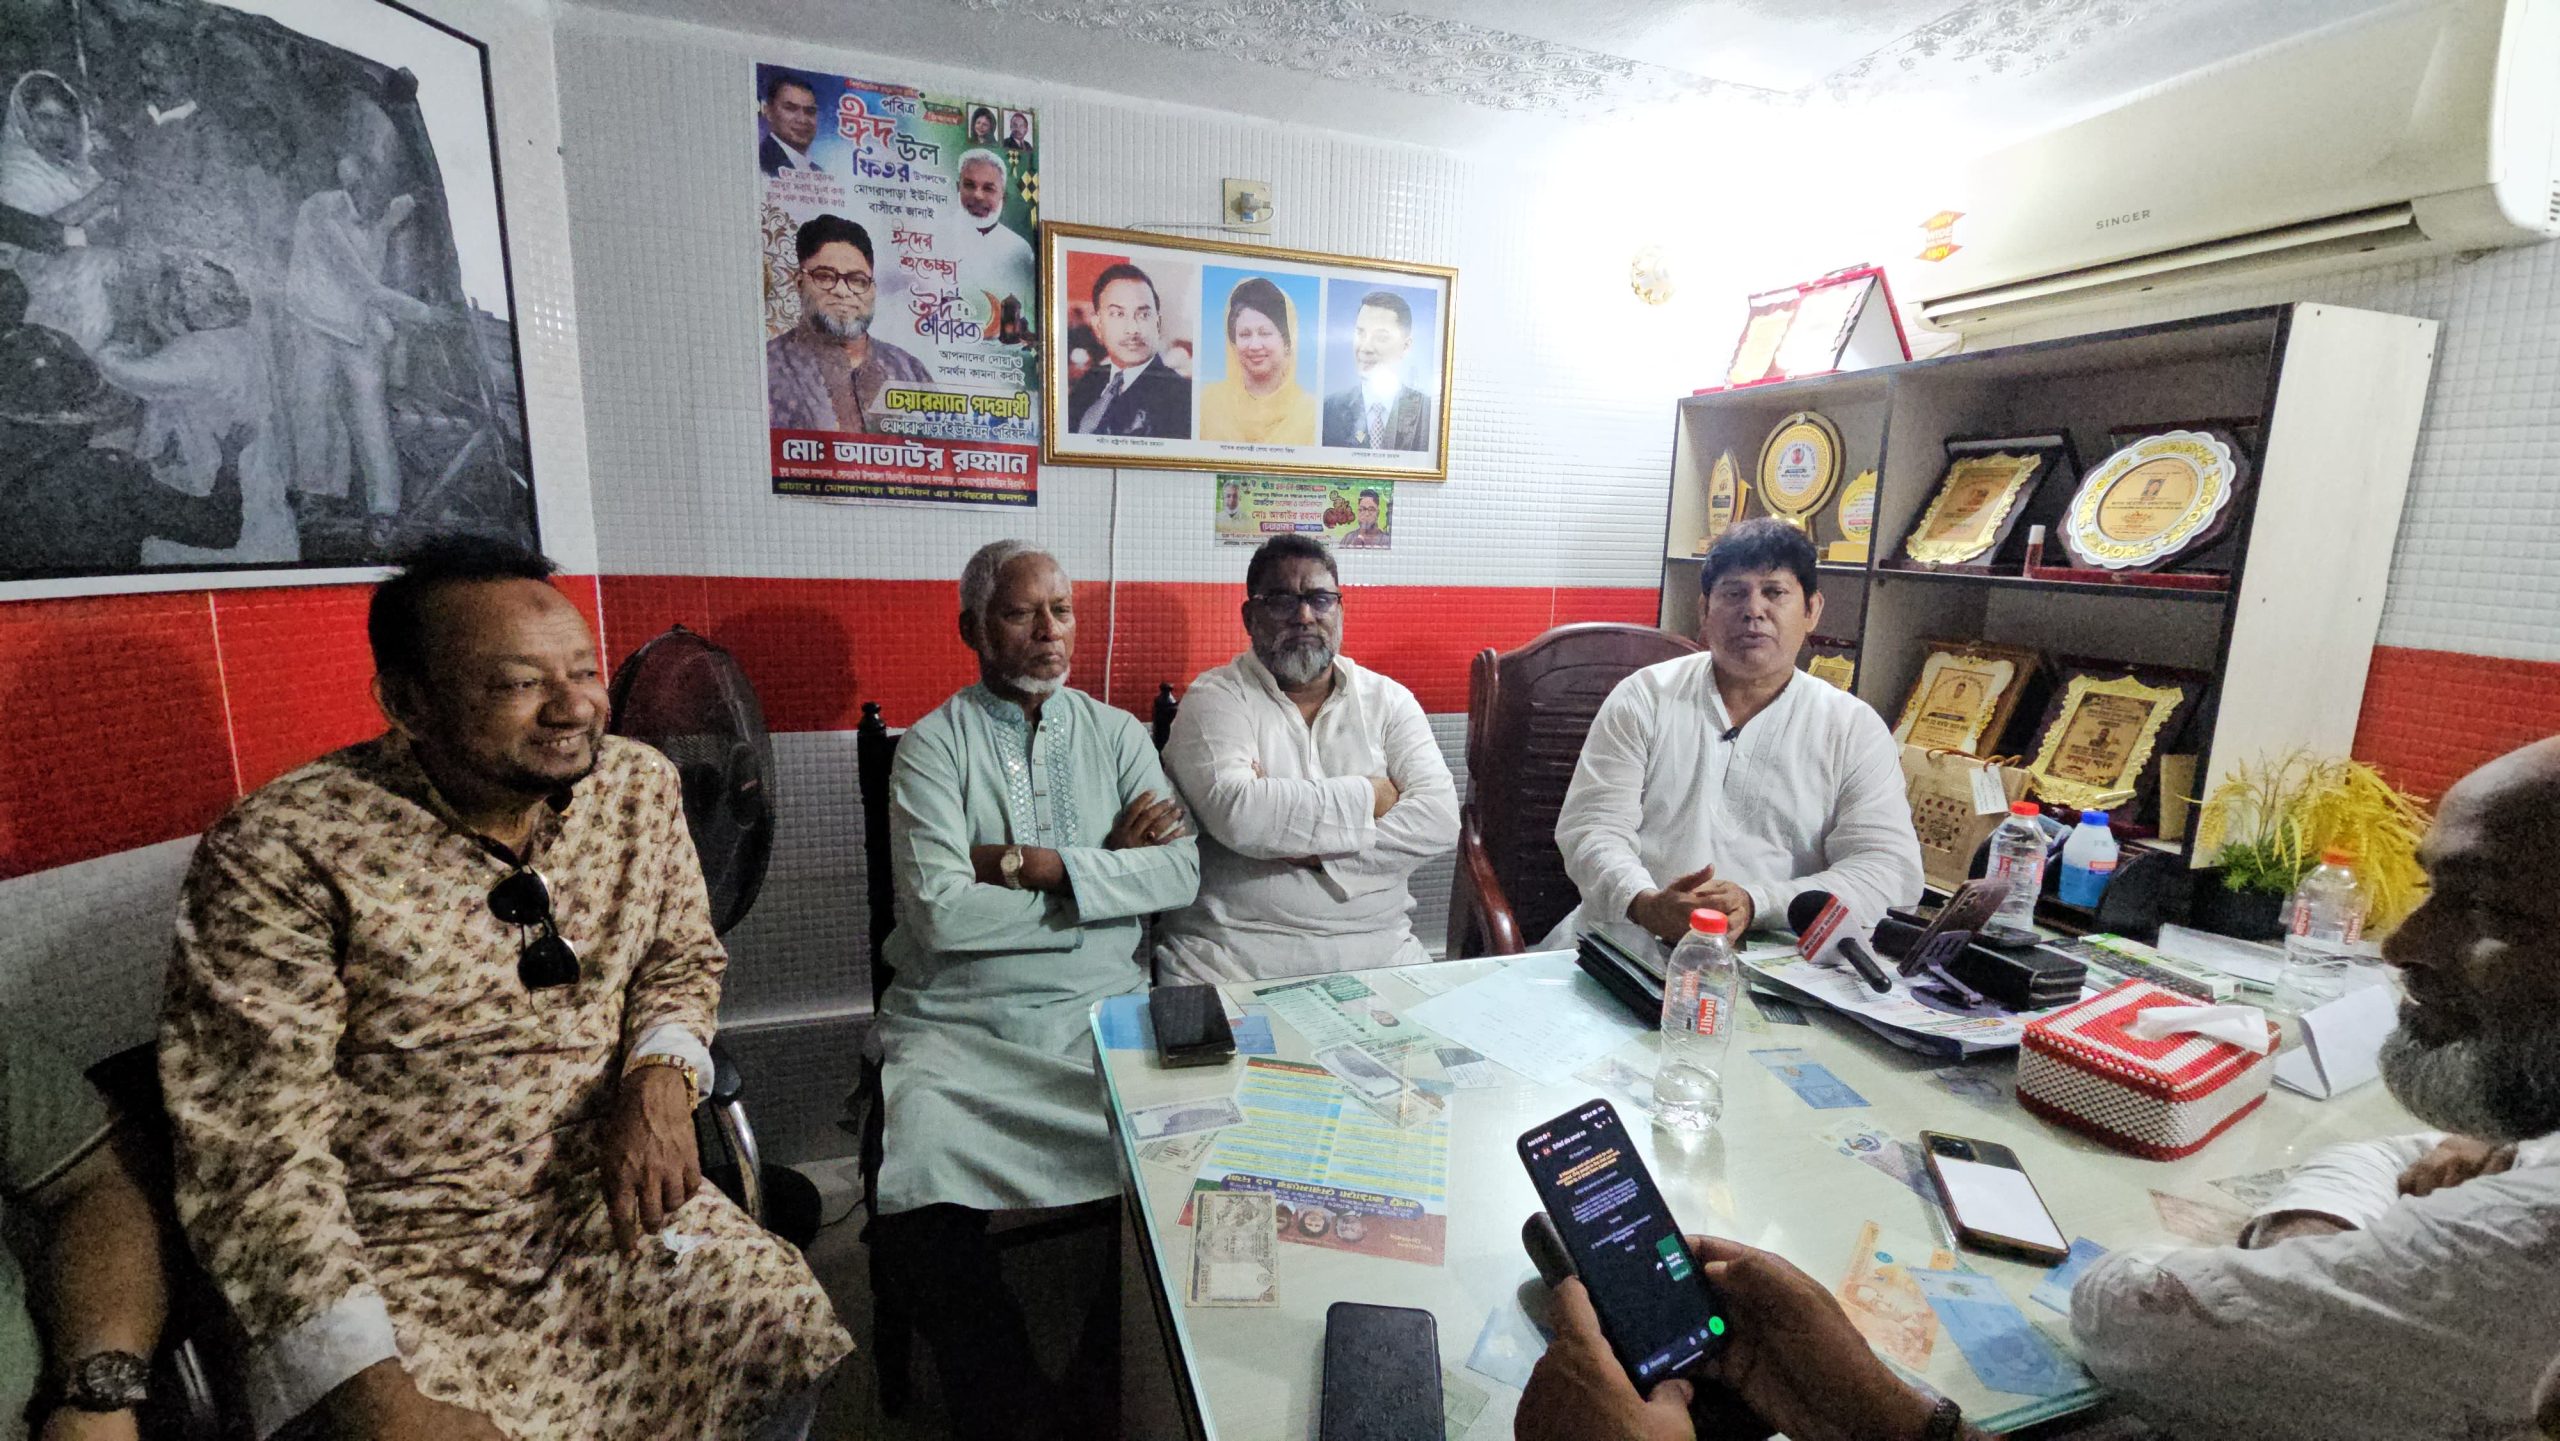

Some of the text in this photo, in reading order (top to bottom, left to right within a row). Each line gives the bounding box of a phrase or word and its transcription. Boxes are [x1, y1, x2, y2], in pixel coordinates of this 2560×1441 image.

[881, 96, 917, 116] পবিত্র
[838, 95, 897, 150] ঈদ
[895, 132, 940, 166] উল
[852, 147, 910, 182] ফিতর
[909, 188, 948, 204] ইউনিয়ন
[868, 200, 935, 219] বাসীকে জানাই
[2095, 209, 2152, 230] SINGER
[890, 219, 934, 253] ঈদের
[899, 252, 958, 285] শুভেচ্ছা
[938, 350, 986, 363] আপনাদের
[988, 354, 1012, 368] দোয়া
[938, 365, 1025, 386] সমর্থন কামনা করছি
[886, 388, 969, 414] চেয়ারম্যান
[880, 418, 1029, 440] মোগরাপাড়া ইউনিয়ন পরিষদ
[832, 439, 945, 472] আতাউর
[951, 449, 1029, 474] রহমান
